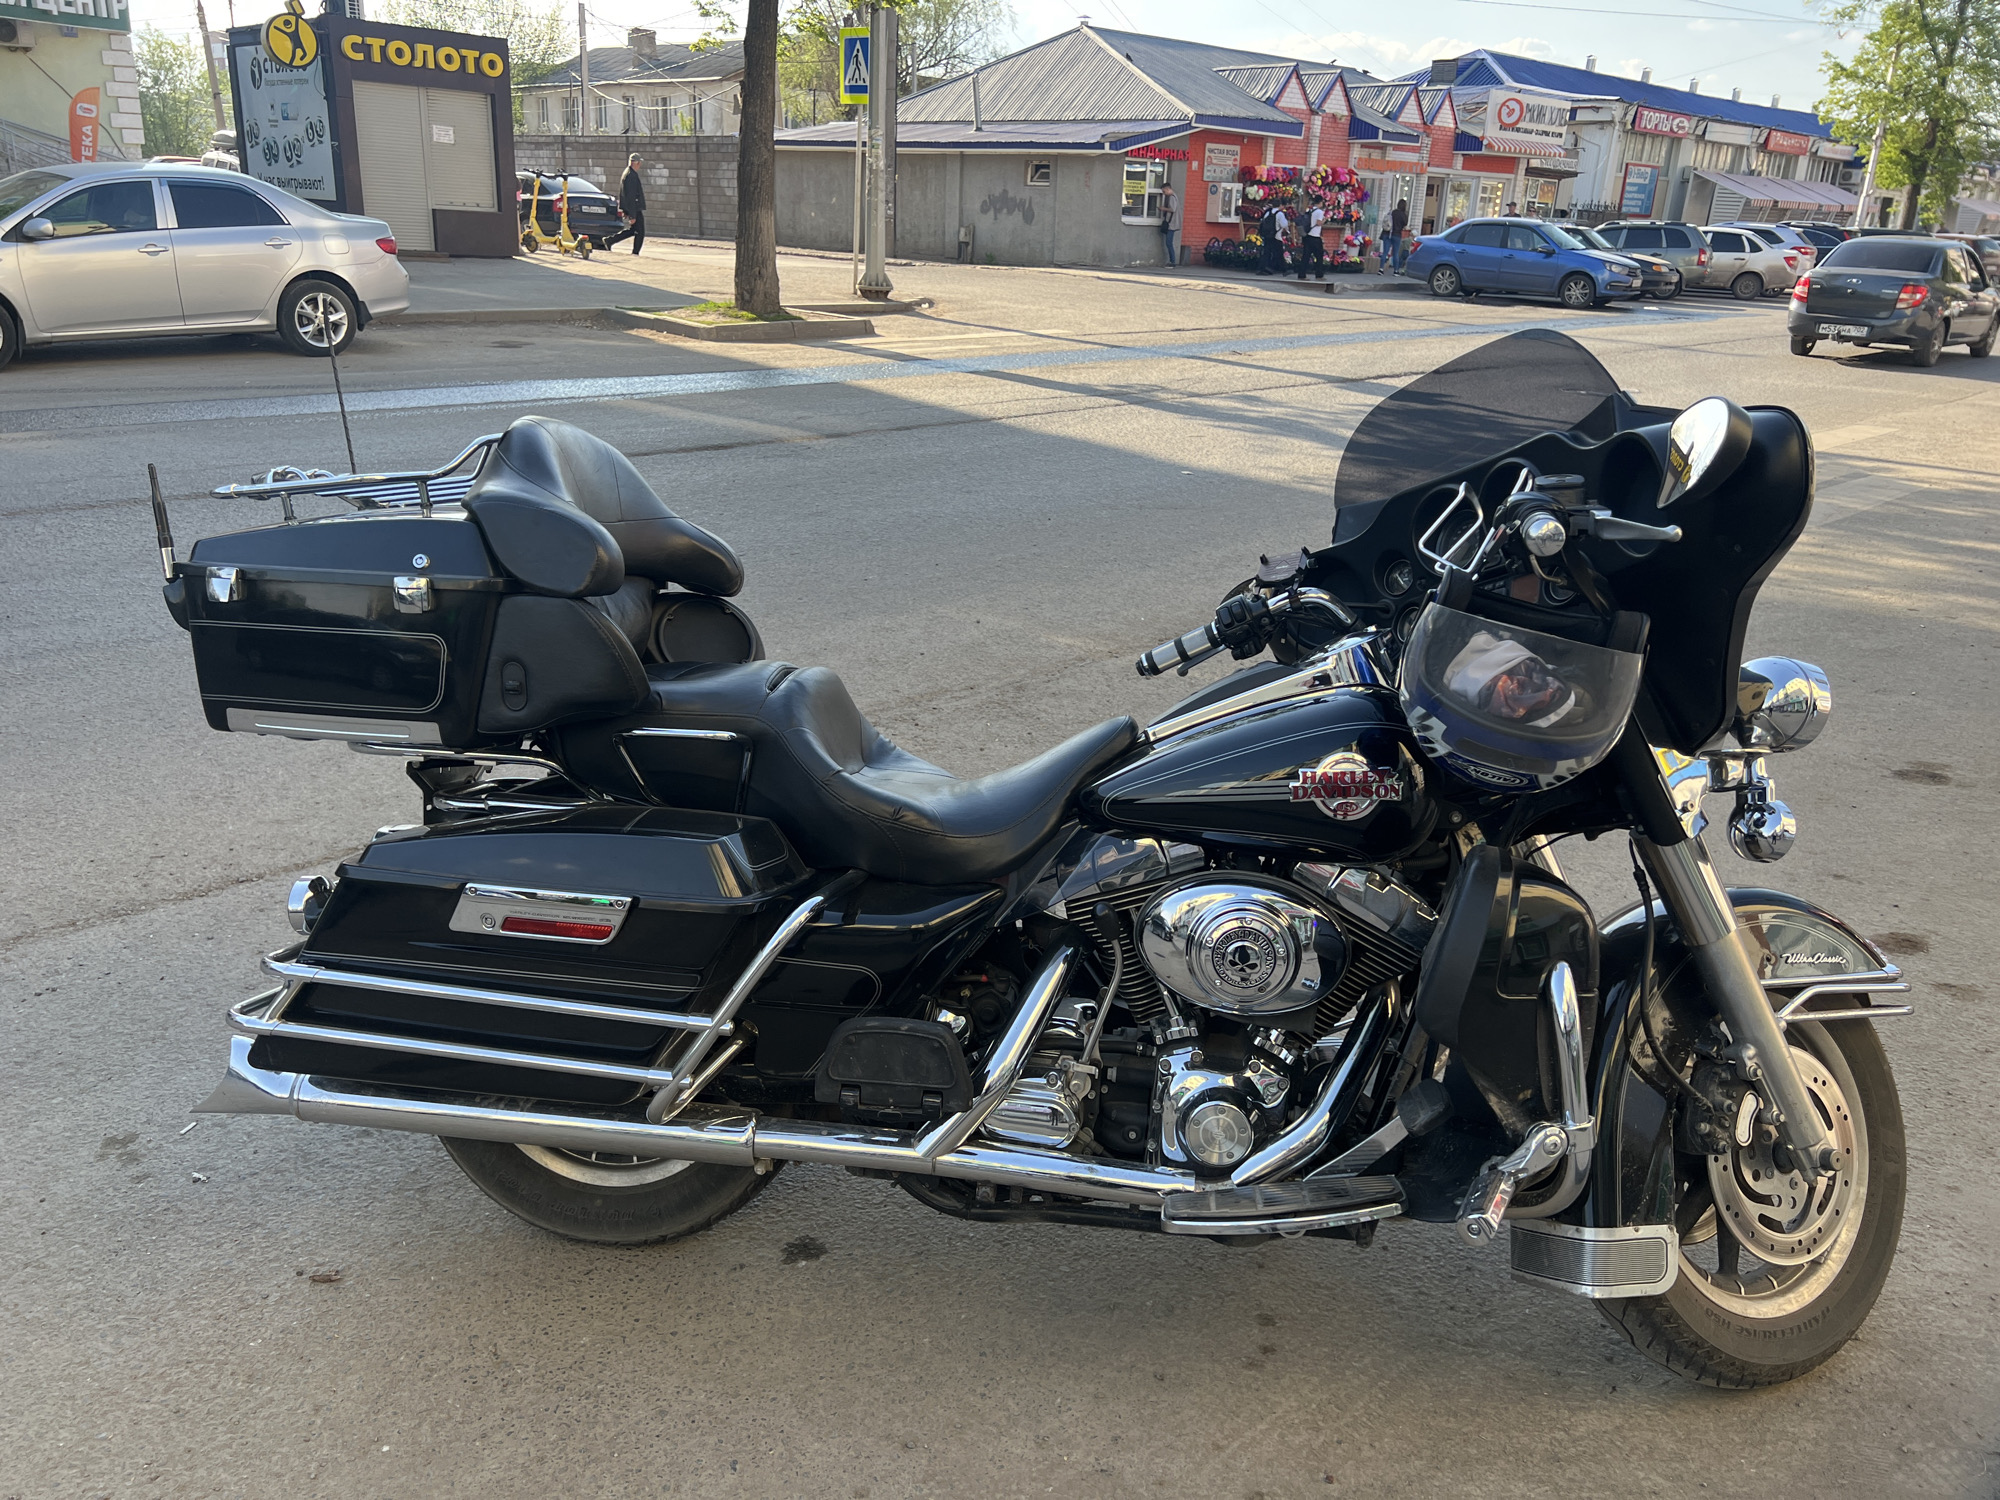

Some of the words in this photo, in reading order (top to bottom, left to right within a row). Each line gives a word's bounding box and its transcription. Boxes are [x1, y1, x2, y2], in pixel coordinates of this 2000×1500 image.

[341, 34, 504, 78] СТОЛОТО
[1641, 110, 1673, 132] ТОРТЫ
[1128, 145, 1191, 160] ТАНДЫРНАЯ
[1207, 147, 1225, 155] ЧИСТАЯ
[276, 175, 325, 193] выигрывают!
[1301, 770, 1389, 785] HARLEY
[1292, 784, 1400, 800] DAVIDSON
[1340, 802, 1357, 812] USA
